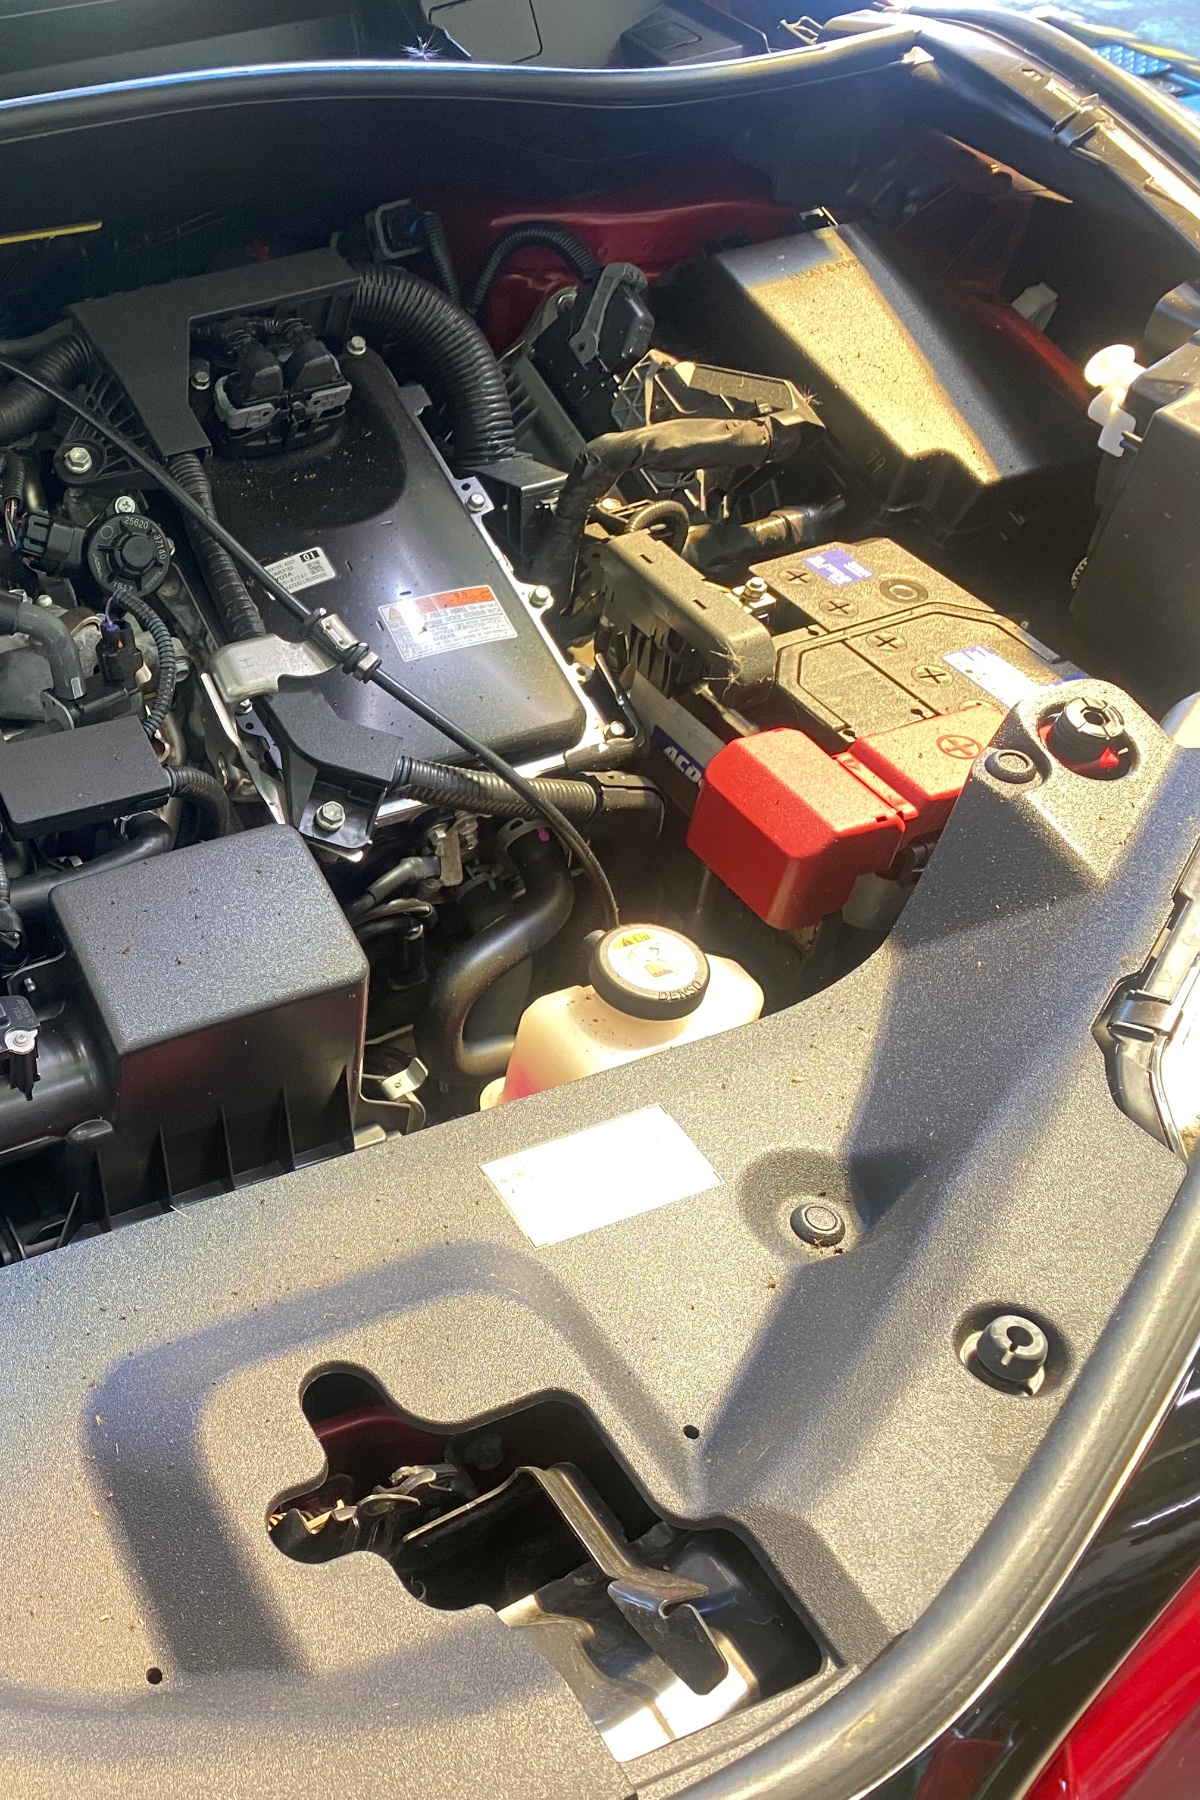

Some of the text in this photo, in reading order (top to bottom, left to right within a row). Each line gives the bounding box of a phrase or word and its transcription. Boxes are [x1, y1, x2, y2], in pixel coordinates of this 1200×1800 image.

[124, 515, 167, 560] 25620 37140
[302, 551, 316, 561] 01
[657, 980, 702, 1001] DENSO
